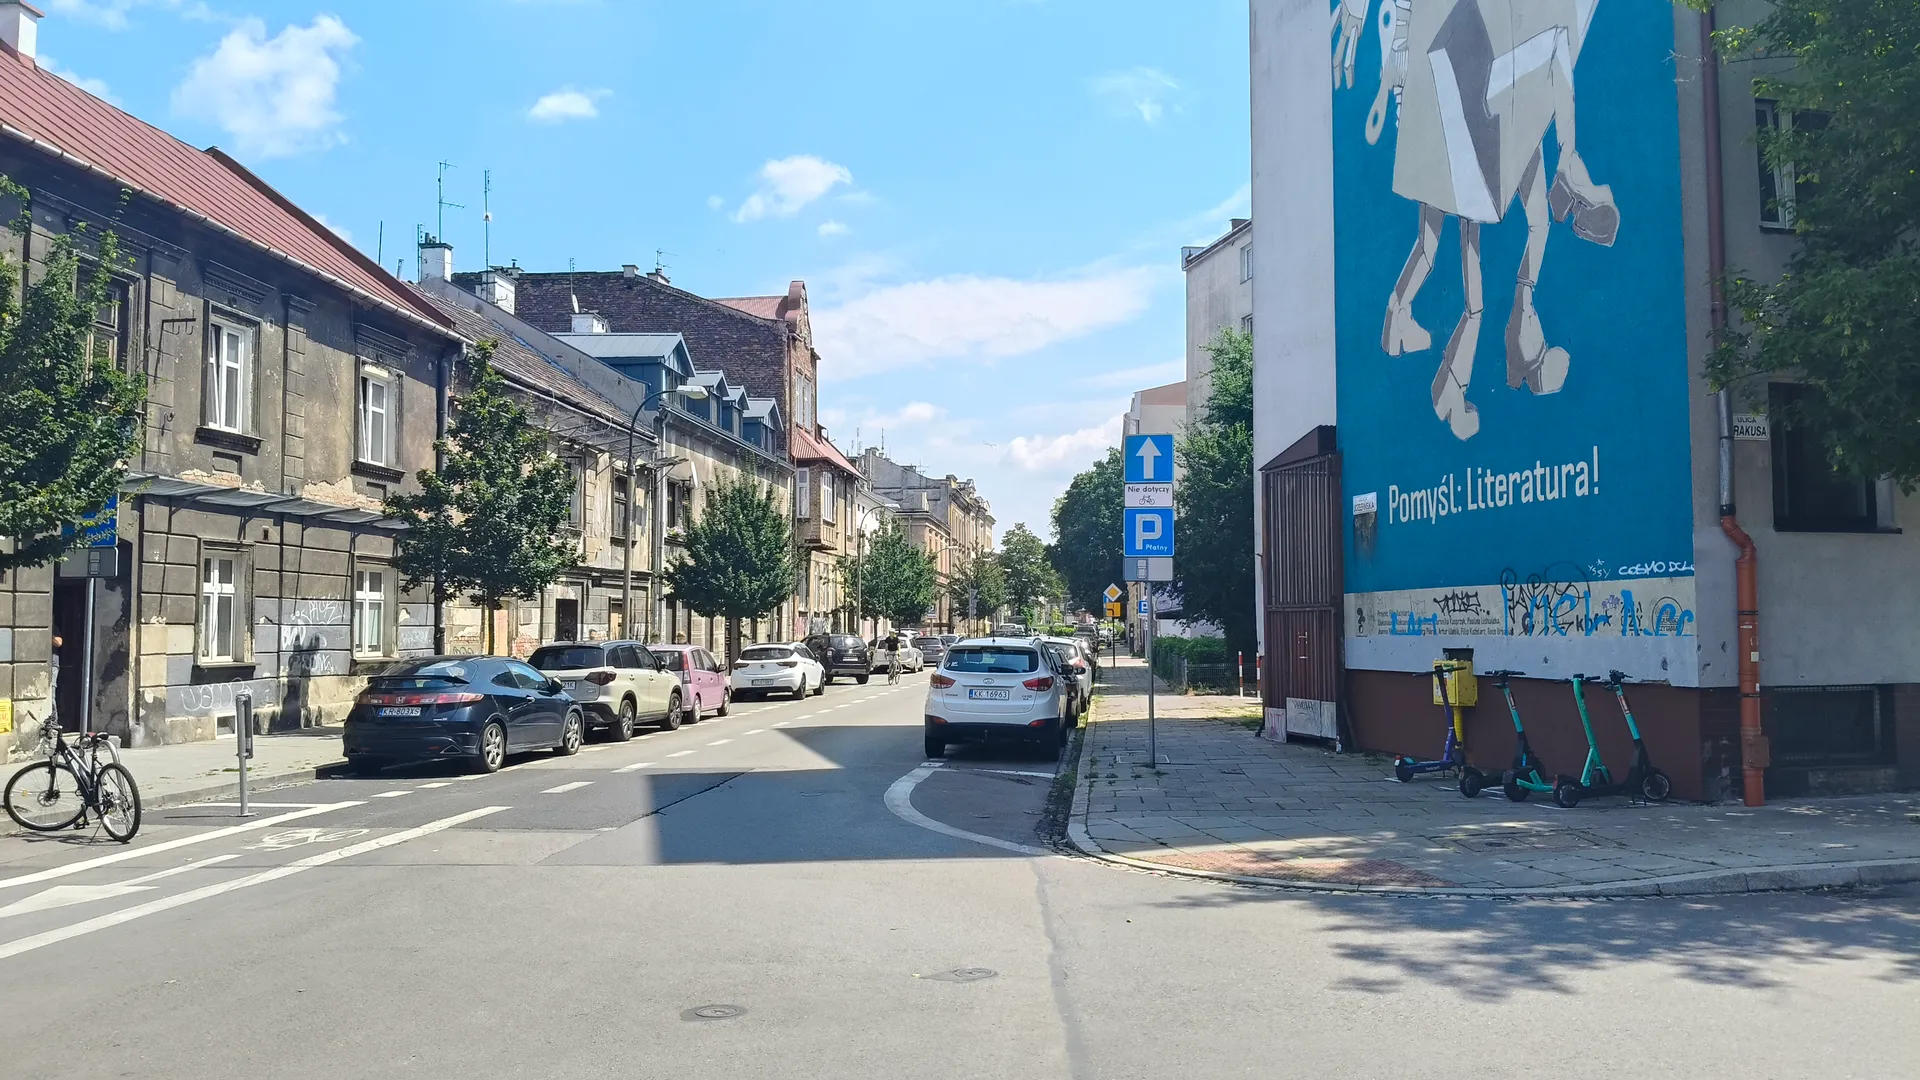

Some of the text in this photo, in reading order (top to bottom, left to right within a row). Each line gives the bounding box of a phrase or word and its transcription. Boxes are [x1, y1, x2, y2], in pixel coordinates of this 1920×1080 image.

[1388, 446, 1600, 524] Pomyśl: Literatura!
[1142, 486, 1170, 494] dotyczy
[1135, 513, 1163, 550] P
[1145, 544, 1168, 552] Płatny
[973, 690, 1007, 698] KK 16963
